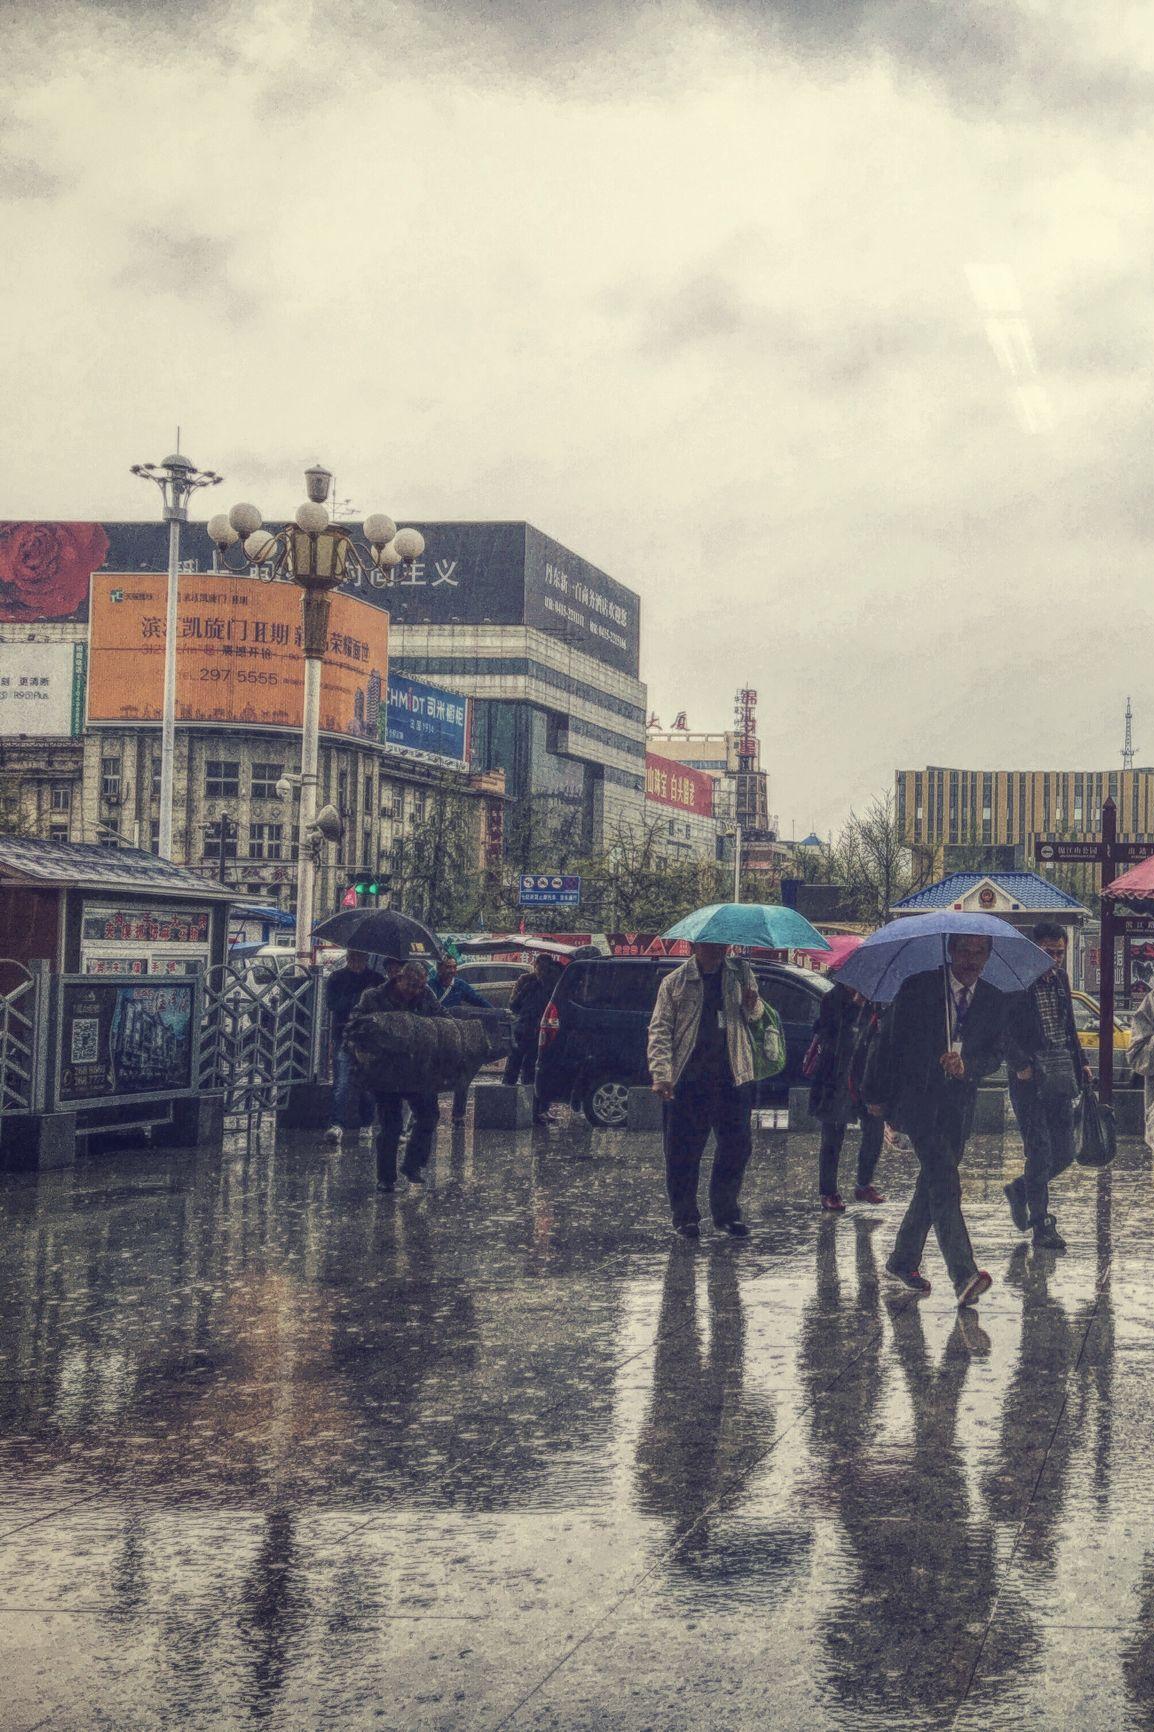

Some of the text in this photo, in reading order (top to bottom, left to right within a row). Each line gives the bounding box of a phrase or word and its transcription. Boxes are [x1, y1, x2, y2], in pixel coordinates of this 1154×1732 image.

[200, 669, 232, 682] 297
[237, 671, 278, 686] 5555
[740, 689, 757, 757] 锦江之星
